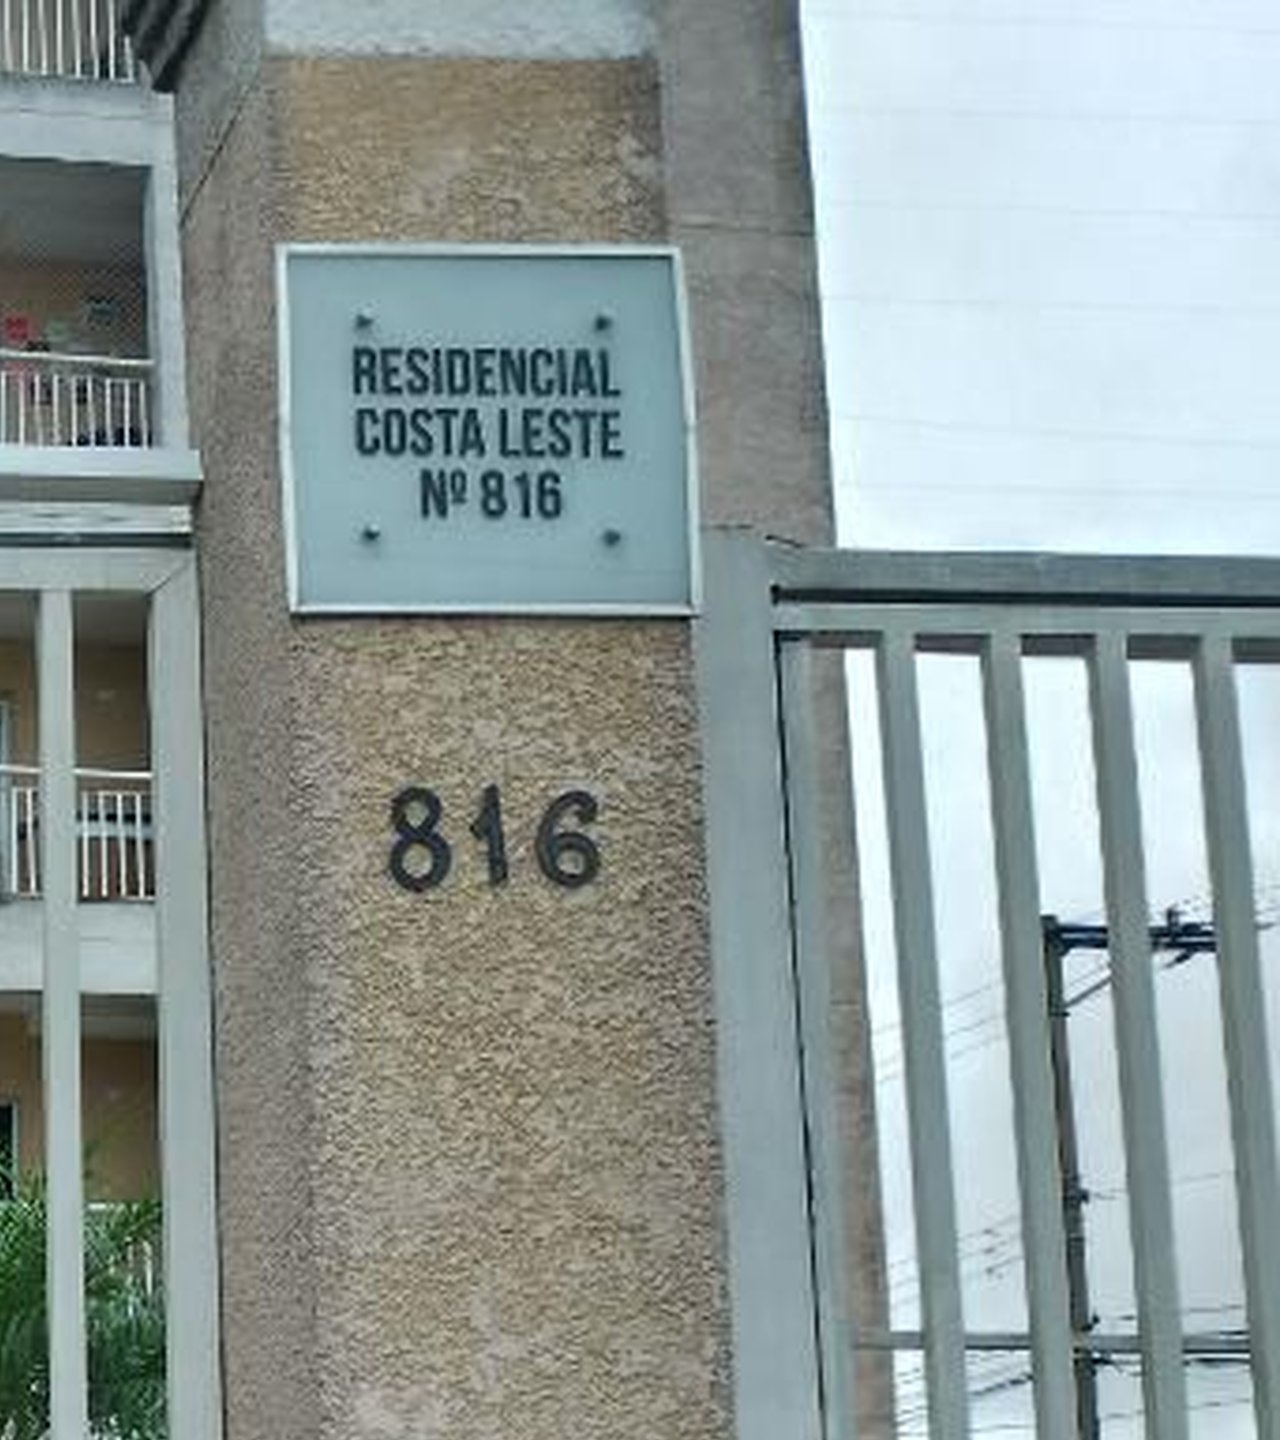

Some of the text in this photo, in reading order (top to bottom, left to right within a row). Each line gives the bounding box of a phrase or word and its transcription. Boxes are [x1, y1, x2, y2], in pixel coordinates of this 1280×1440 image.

[352, 347, 621, 398] RESIDENCIAL
[356, 408, 625, 459] COSTA LESTE
[480, 471, 563, 520] 816
[389, 784, 600, 892] 816
